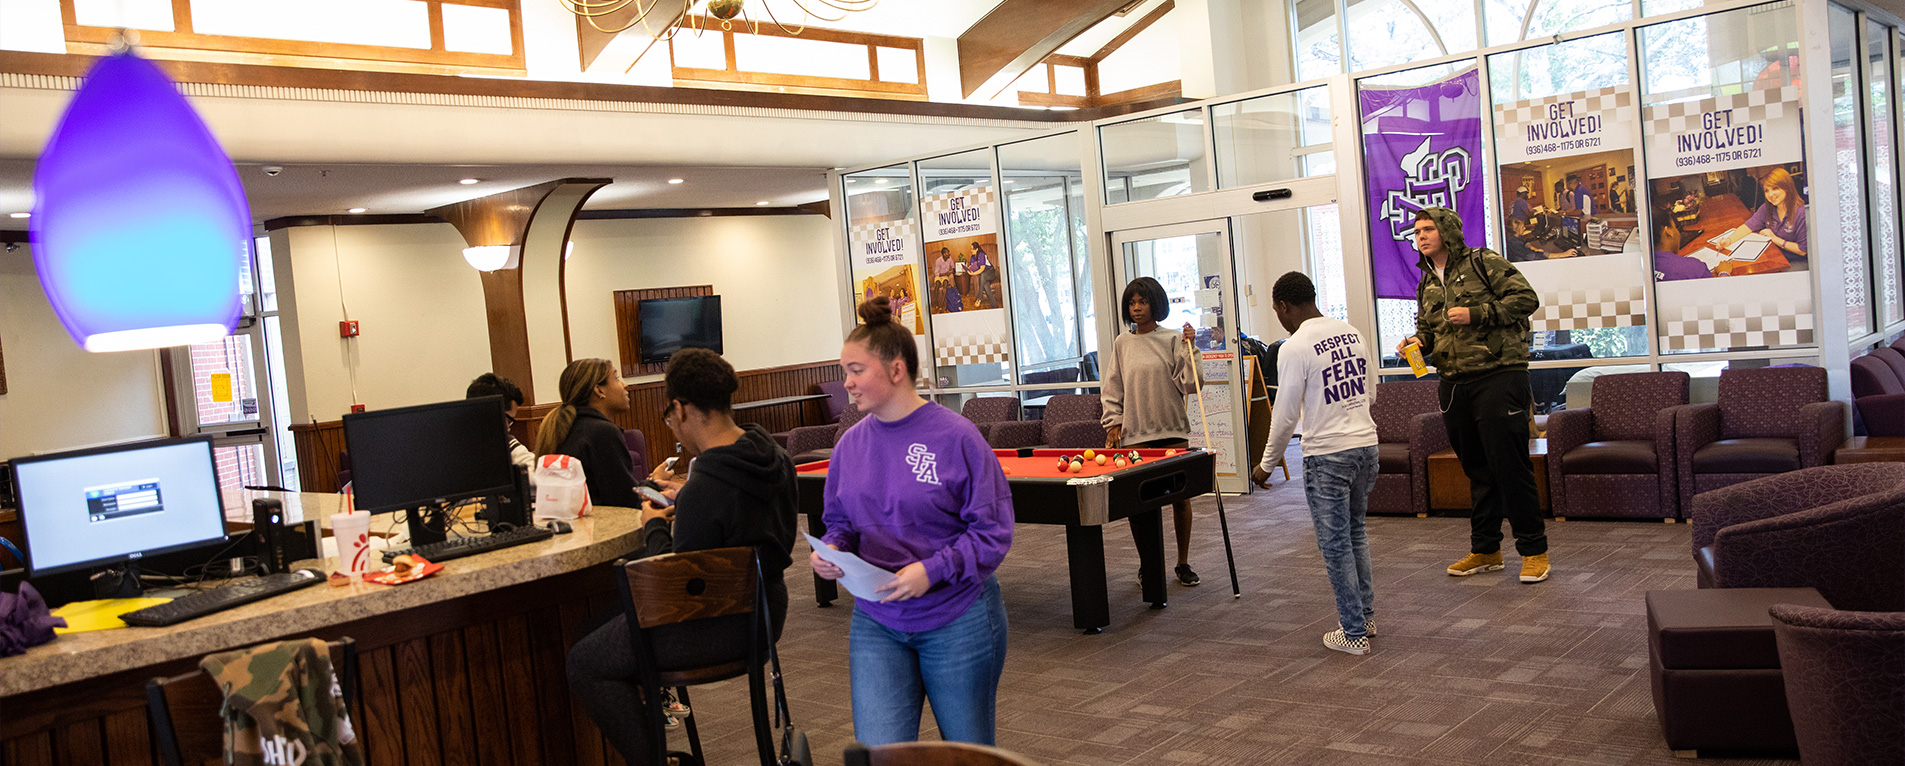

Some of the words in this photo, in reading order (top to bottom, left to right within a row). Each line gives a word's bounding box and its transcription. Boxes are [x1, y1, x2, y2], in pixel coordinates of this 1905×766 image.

[1549, 101, 1575, 121] GET
[1703, 109, 1733, 131] GET
[1526, 114, 1602, 142] INVOLVED!
[1525, 141, 1574, 156] (936)468-1175
[1575, 139, 1585, 149] OR
[1585, 137, 1601, 148] 6721
[1677, 124, 1763, 153] INVOLVED!
[1675, 151, 1731, 168] (936)468-1175
[1731, 150, 1743, 160] OR
[1743, 148, 1762, 159] 6721
[950, 197, 965, 210] GET
[938, 207, 980, 226] INVOLVED!
[876, 227, 890, 241] GET
[865, 238, 904, 255] INVOLVED!
[1314, 334, 1360, 355] RESPECT
[1331, 346, 1356, 363] ALL
[1322, 358, 1366, 386] FEAR
[905, 443, 940, 484] SFA
